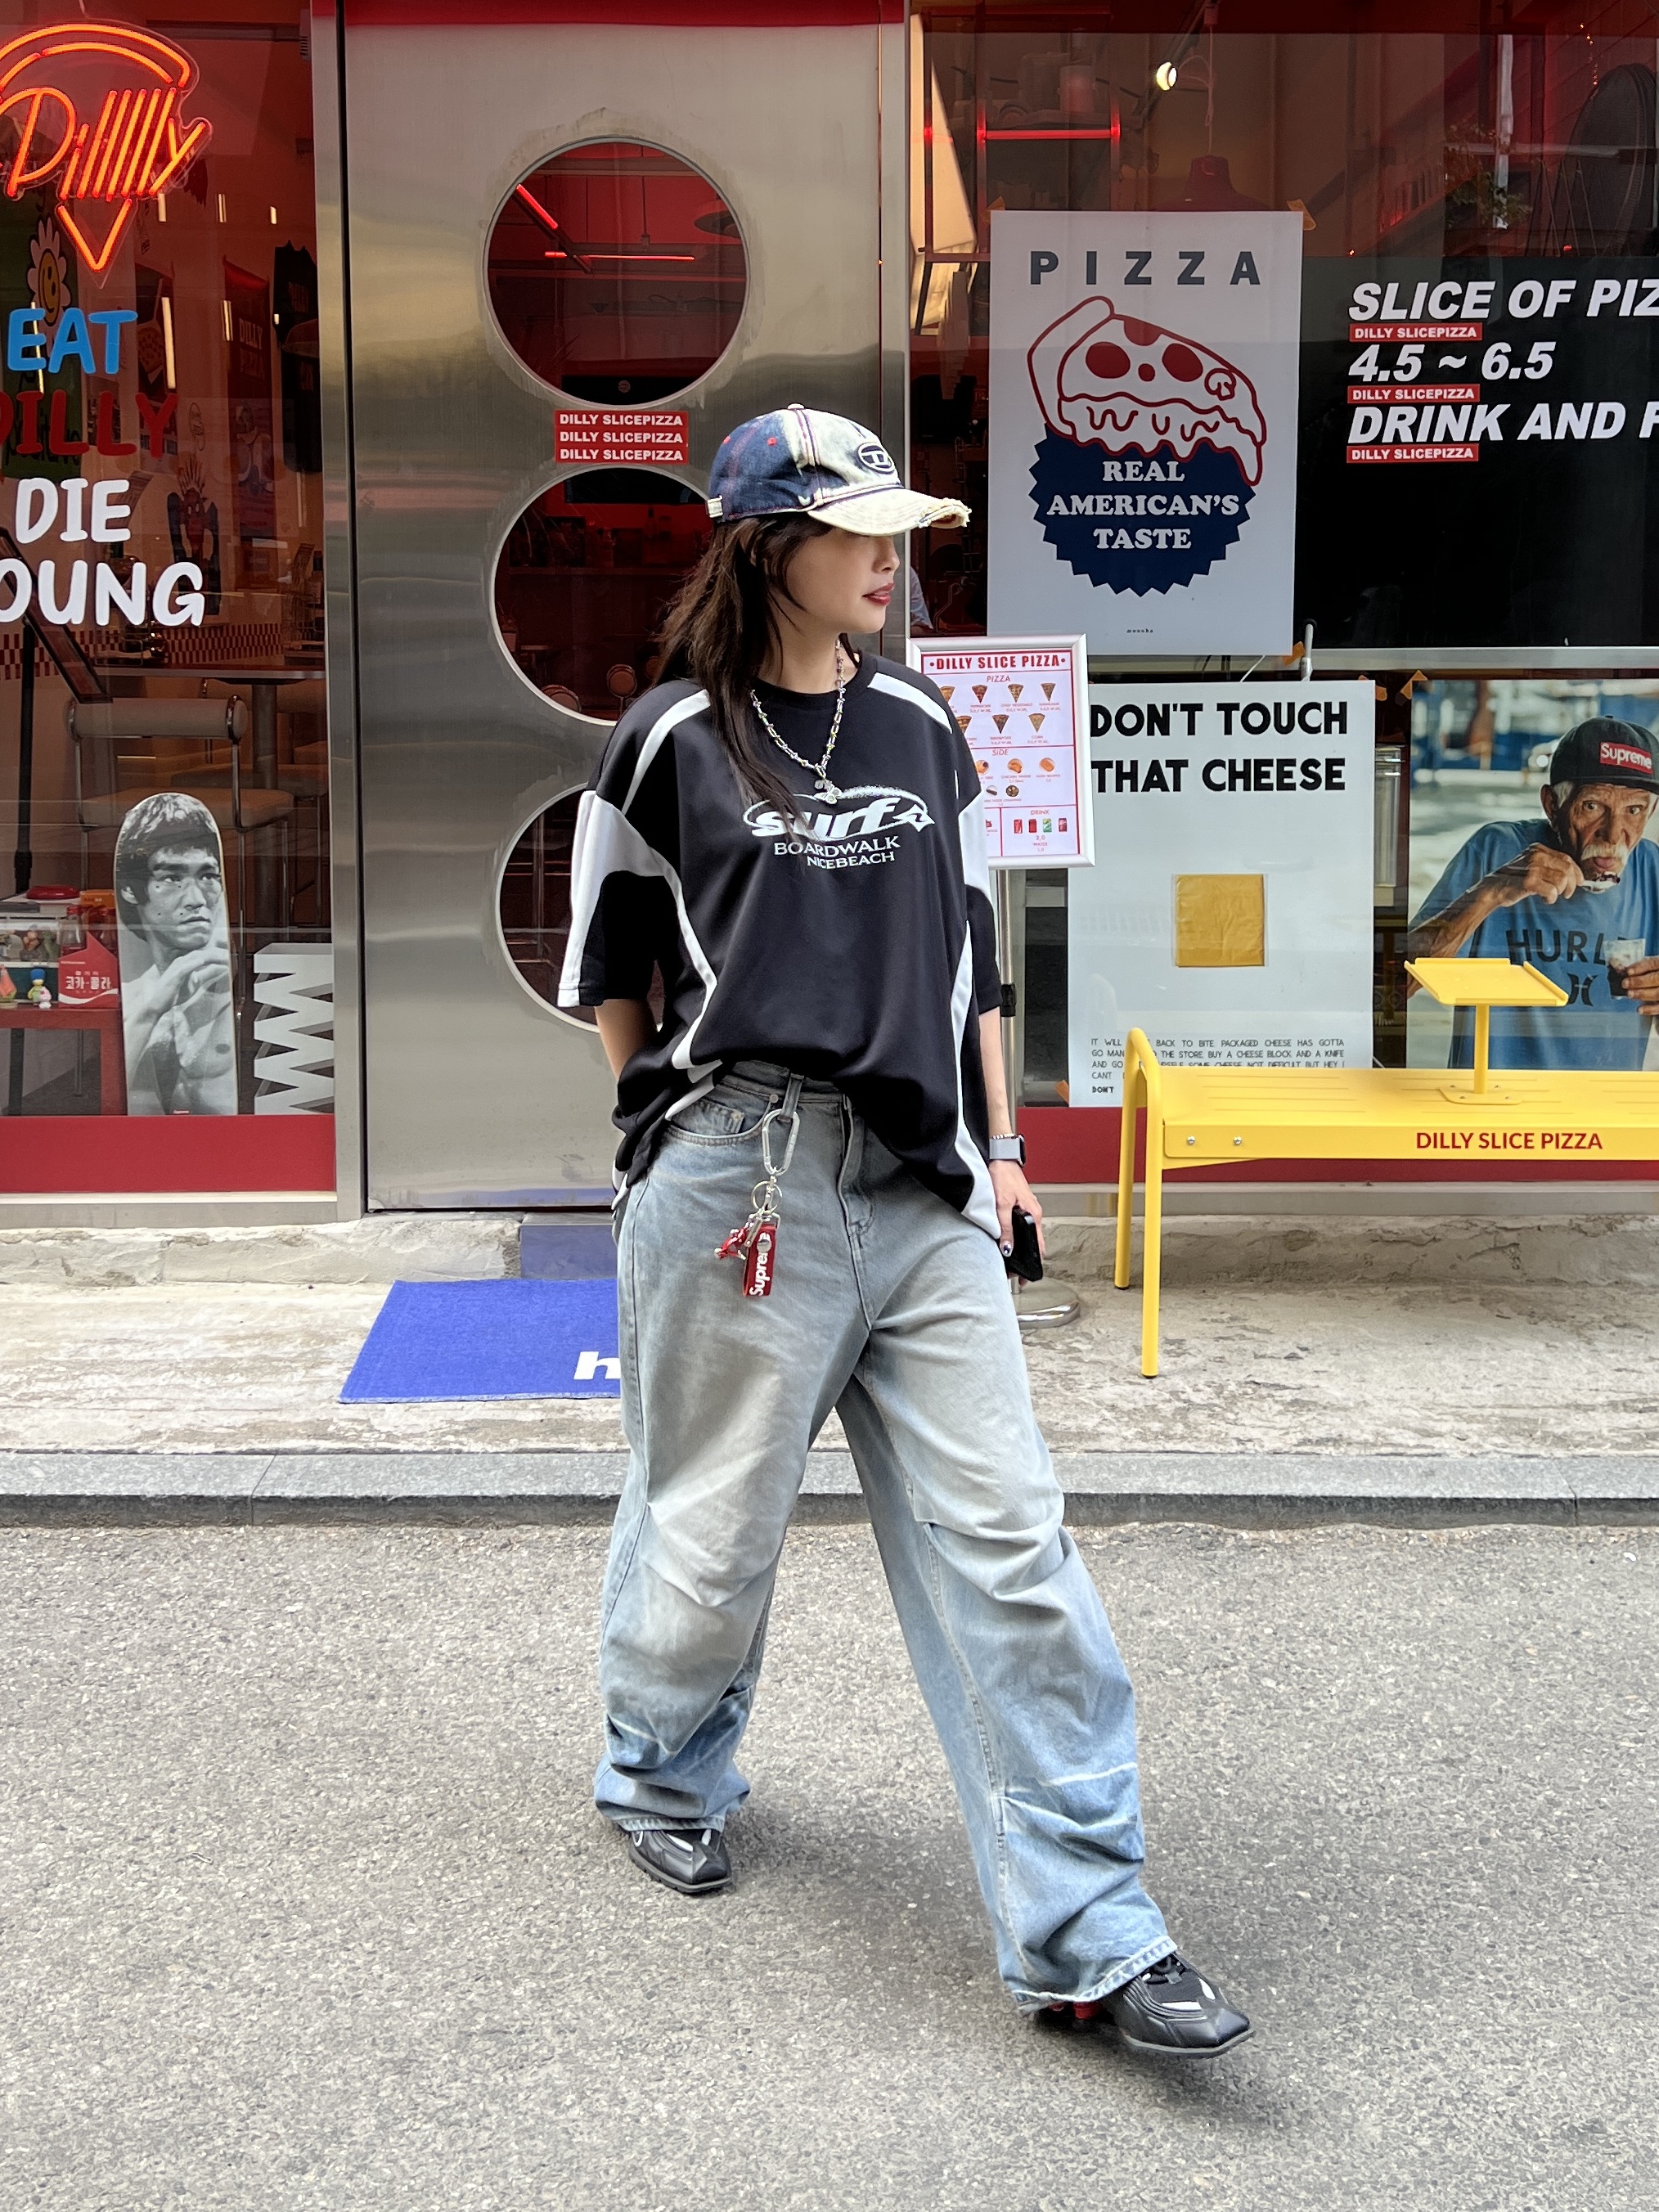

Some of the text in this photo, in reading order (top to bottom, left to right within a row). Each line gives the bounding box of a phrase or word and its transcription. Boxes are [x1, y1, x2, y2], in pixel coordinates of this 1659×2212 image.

[1030, 250, 1261, 285] PIZZA
[1348, 280, 1496, 321] SLICE
[1508, 279, 1577, 319] OF
[7, 308, 138, 375] EAT
[1355, 326, 1477, 339] DILLY SLICEPIZZA
[1348, 344, 1426, 382] 4.5
[1481, 342, 1556, 380] 6.5
[1352, 389, 1475, 400] DILLY SLICEPIZZA
[560, 414, 683, 425] DILLY SLICEPIZZA
[1347, 403, 1511, 444] DRINK
[1517, 402, 1626, 441] AND
[560, 431, 683, 443] DILLY SLICEPIZZA
[560, 448, 683, 461] DILLY SLICEPIZZA
[1351, 448, 1474, 461] DILLY SLICEPIZZA
[1102, 461, 1185, 482] REAL
[15, 478, 132, 544] DIE
[1046, 494, 1239, 516] AMERICAN'S
[1093, 528, 1192, 549] TASTE
[937, 654, 1059, 670] DILLY SLICE PIZZA
[1090, 701, 1347, 737] DON'T TOUCH
[1601, 743, 1652, 769] Supreme
[1091, 758, 1346, 793] THAT CHEESE
[774, 835, 901, 857] BOARDWALK
[807, 852, 895, 870] NICEBEACH
[1506, 928, 1626, 965] HURL
[1104, 1038, 1122, 1046] WILL
[1156, 1039, 1176, 1047] BACK
[1265, 1039, 1291, 1047] CHEESE
[1319, 1038, 1345, 1046] GOTTA
[1092, 1060, 1124, 1068] AND GO
[1208, 1050, 1222, 1059] BUY
[1324, 1050, 1344, 1058] KNIFE
[1417, 1132, 1603, 1149] DILLY SLICE PIZZA
[749, 1232, 771, 1297] Supree
